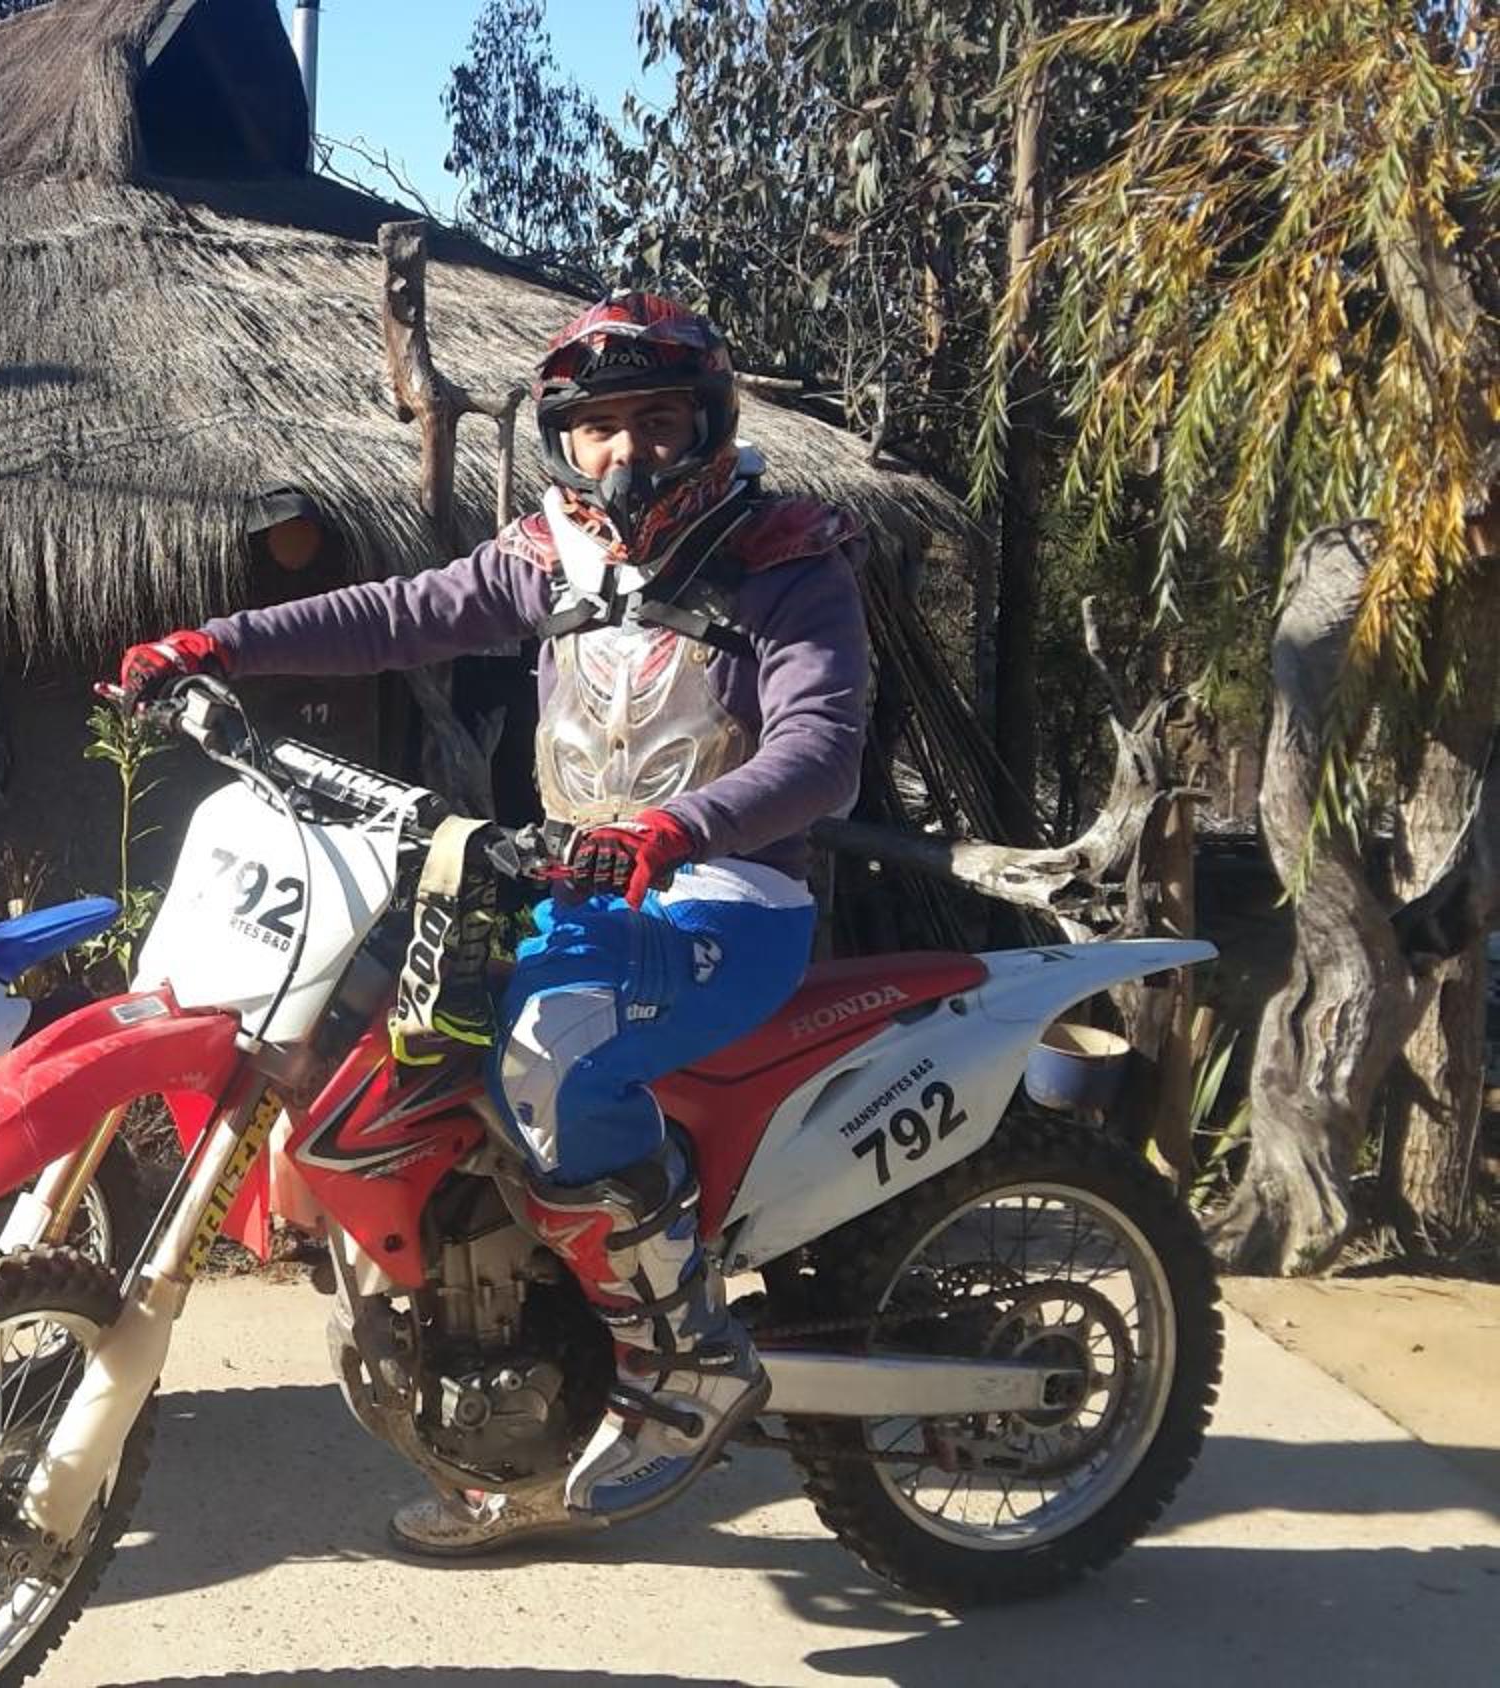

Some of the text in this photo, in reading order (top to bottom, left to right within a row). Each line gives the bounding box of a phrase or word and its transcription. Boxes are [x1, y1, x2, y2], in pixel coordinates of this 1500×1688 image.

[211, 847, 304, 939] 792
[261, 931, 291, 953] B&D
[790, 984, 909, 1041] HONDA
[840, 1074, 912, 1137] TRANSPORTES
[851, 1081, 968, 1187] 792
